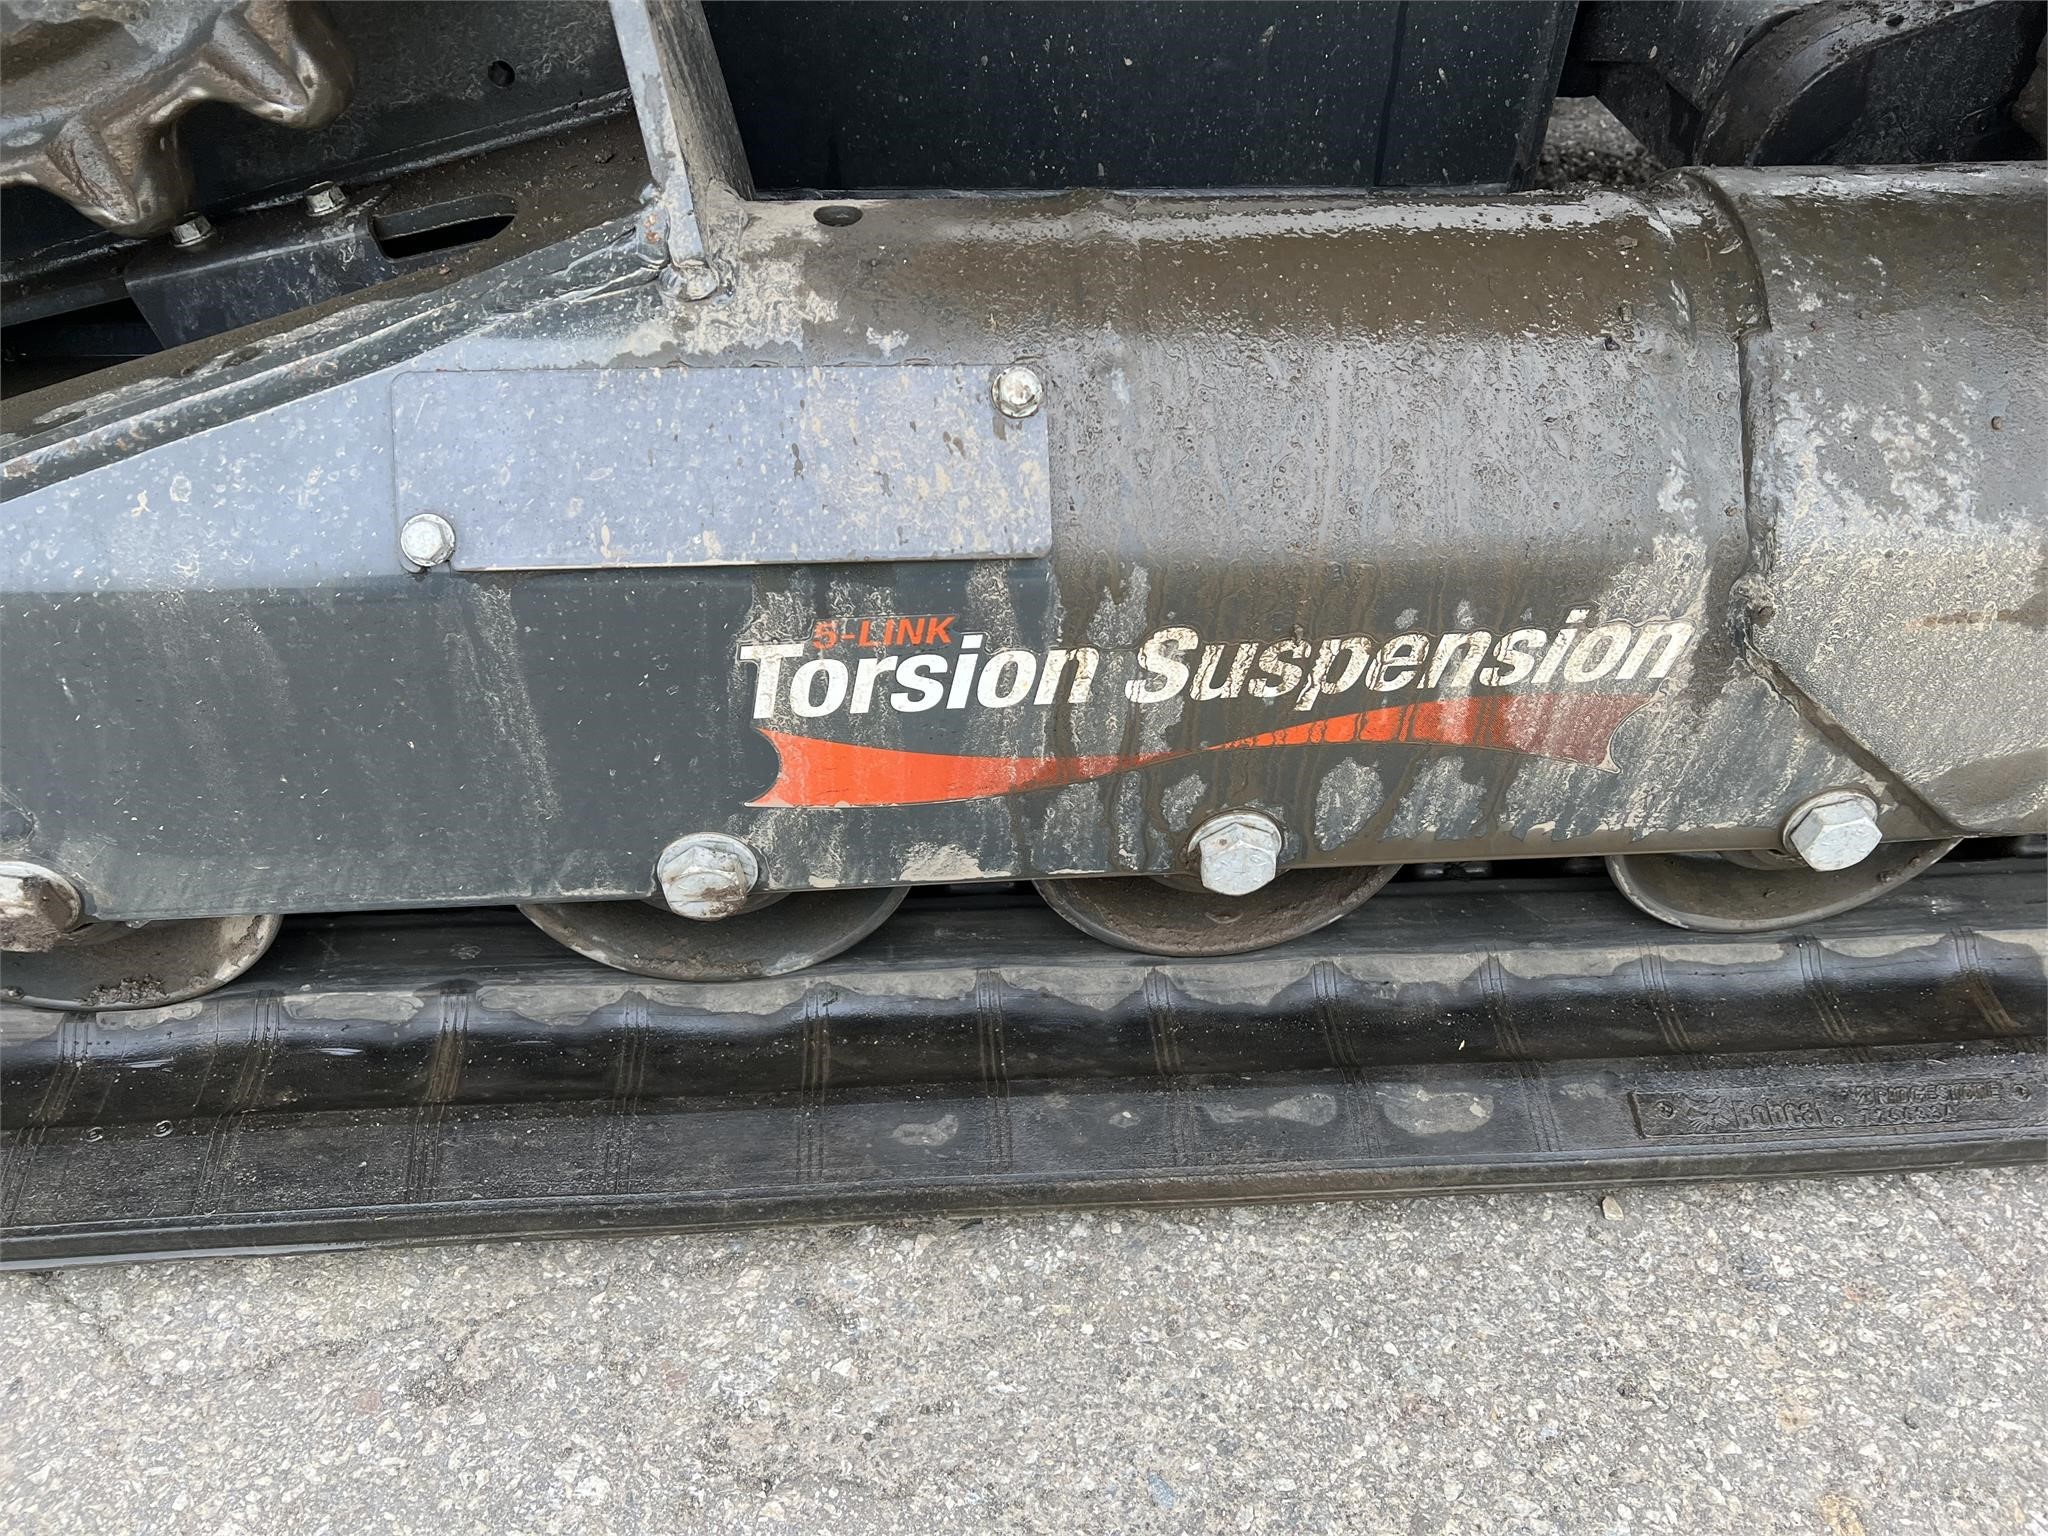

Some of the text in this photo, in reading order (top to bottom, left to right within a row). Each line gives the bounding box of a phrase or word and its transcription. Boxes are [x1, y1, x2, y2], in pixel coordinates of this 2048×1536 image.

[739, 608, 1696, 720] Torsion Suspension
[812, 615, 957, 650] 5-LINK
